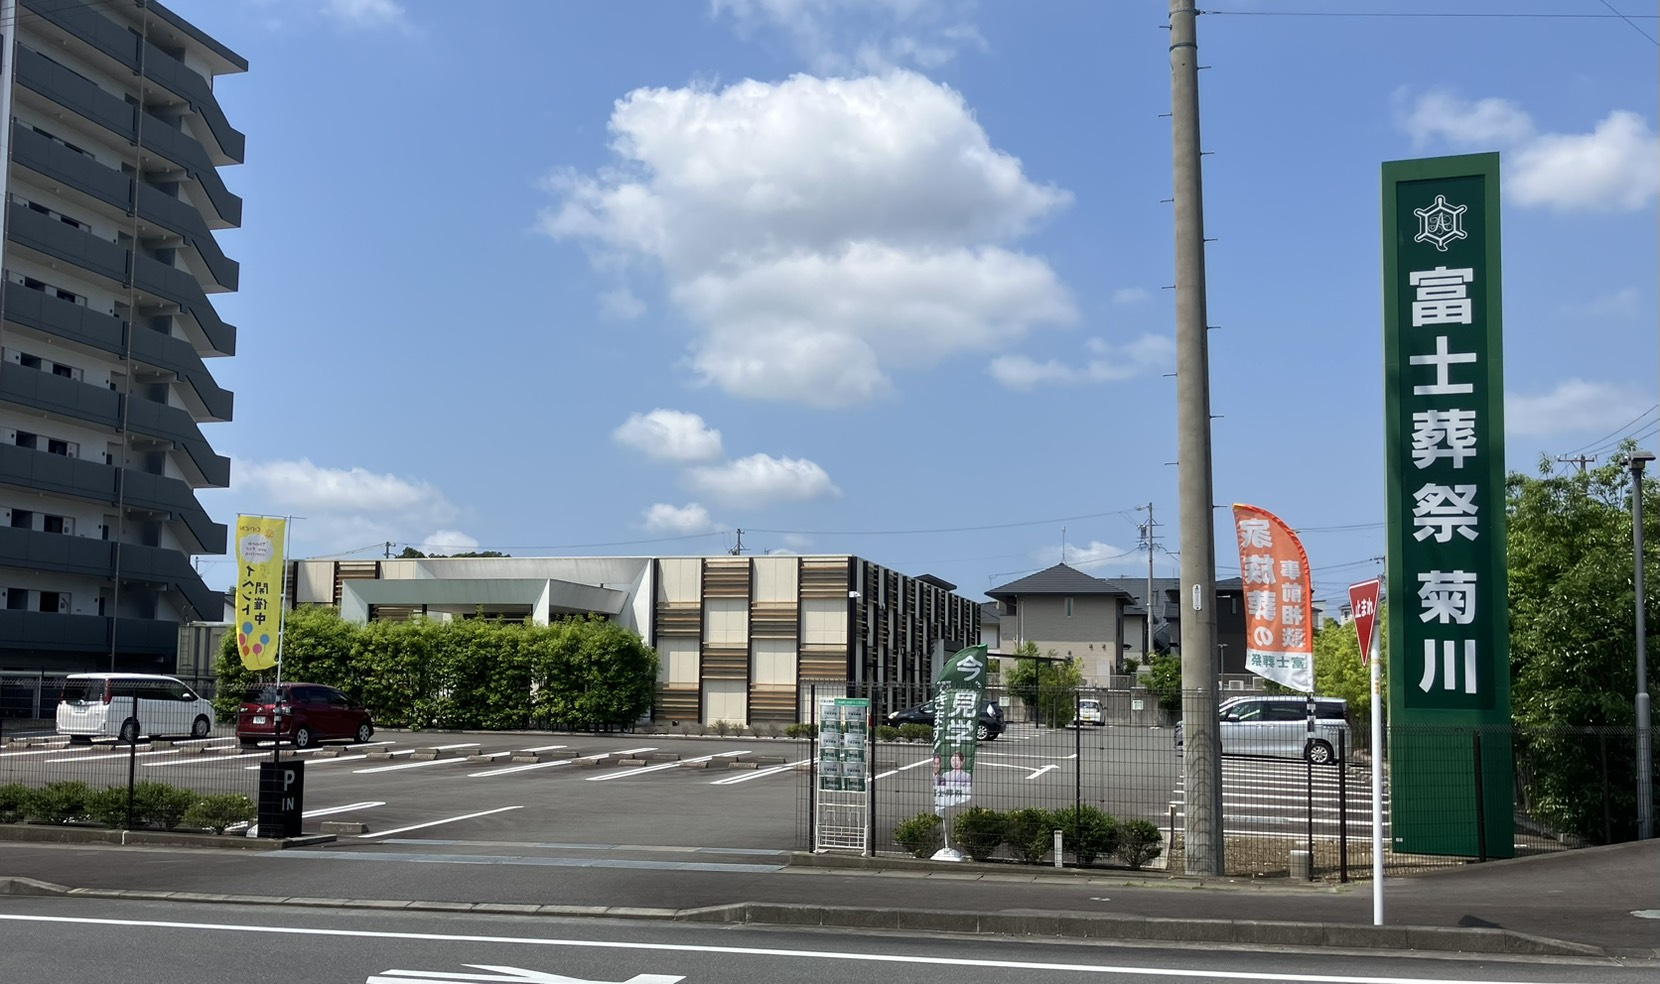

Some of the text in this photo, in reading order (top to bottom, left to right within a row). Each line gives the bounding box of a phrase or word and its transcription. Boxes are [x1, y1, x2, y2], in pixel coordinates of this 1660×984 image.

[1409, 266, 1479, 695] 富士葬祭菊川
[1355, 597, 1374, 618] 止まれ
[283, 769, 296, 792] P
[281, 797, 295, 811] IN
